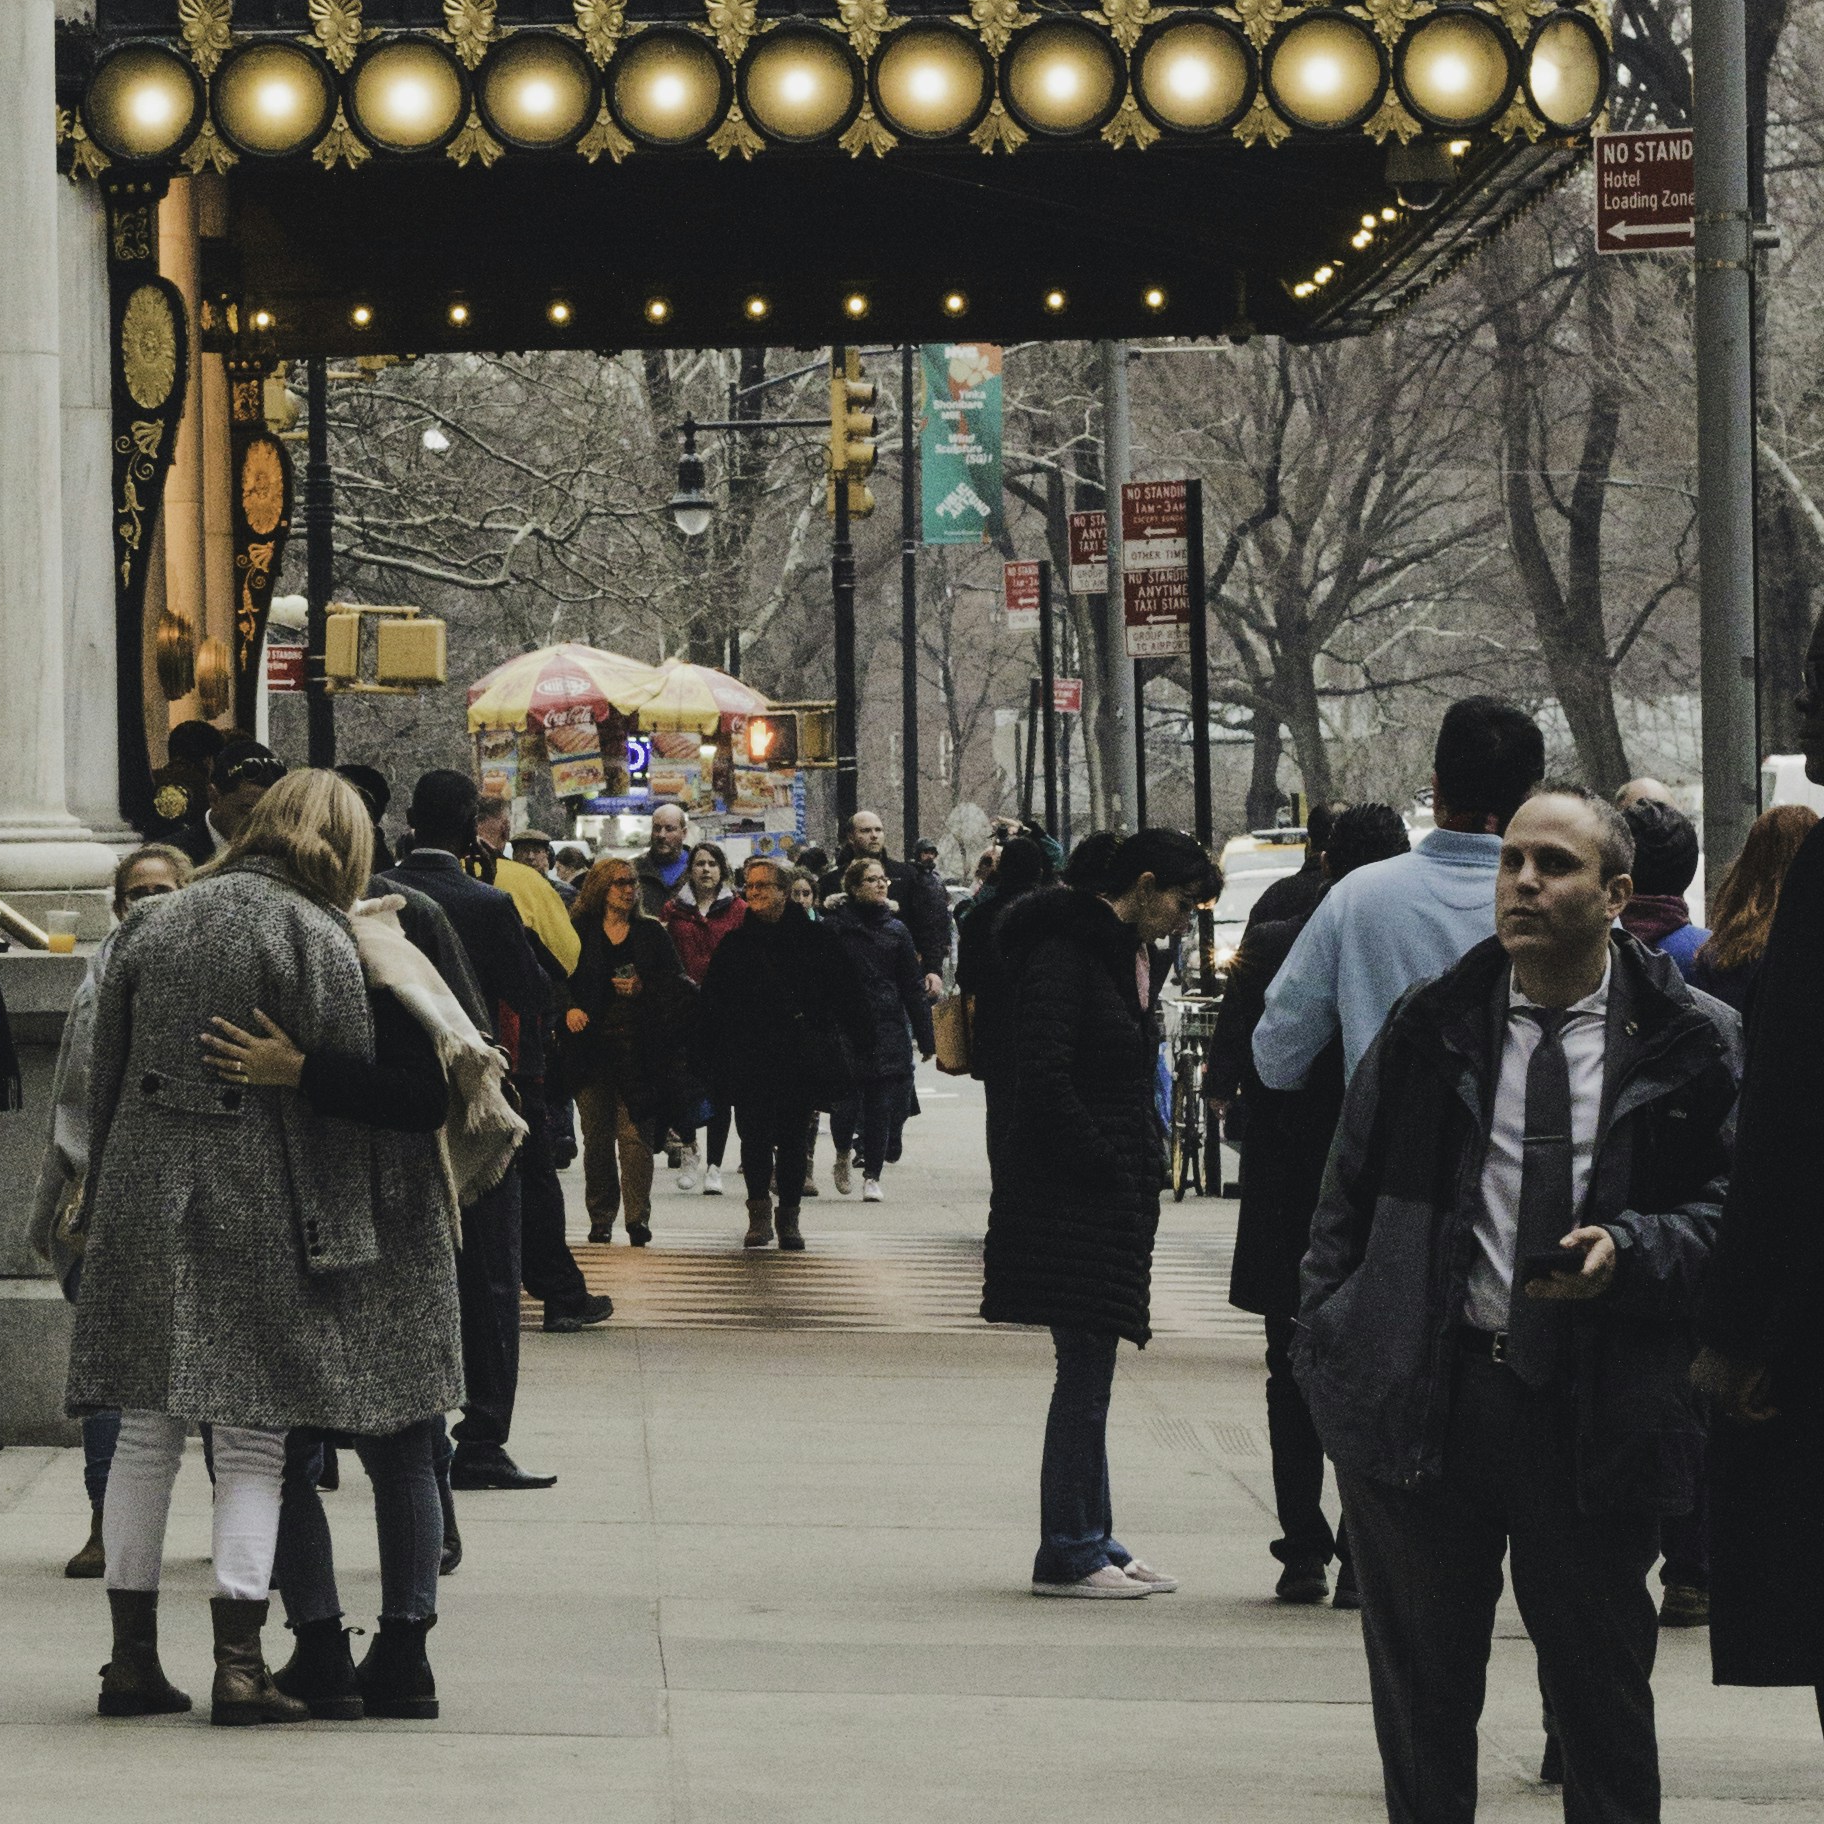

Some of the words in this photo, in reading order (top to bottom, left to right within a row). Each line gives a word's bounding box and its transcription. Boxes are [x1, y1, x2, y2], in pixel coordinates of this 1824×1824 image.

[1604, 142, 1629, 164] NO
[1634, 139, 1694, 163] STAND
[1603, 169, 1641, 188] Hotel
[1603, 192, 1658, 212] Loading
[1661, 189, 1695, 207] Zone
[1127, 488, 1141, 500] NO
[1073, 517, 1086, 527] NO
[1079, 540, 1098, 552] TAXI
[1129, 574, 1143, 585] NO
[1138, 585, 1189, 598] ANYTIME
[1134, 600, 1157, 612] TAXI
